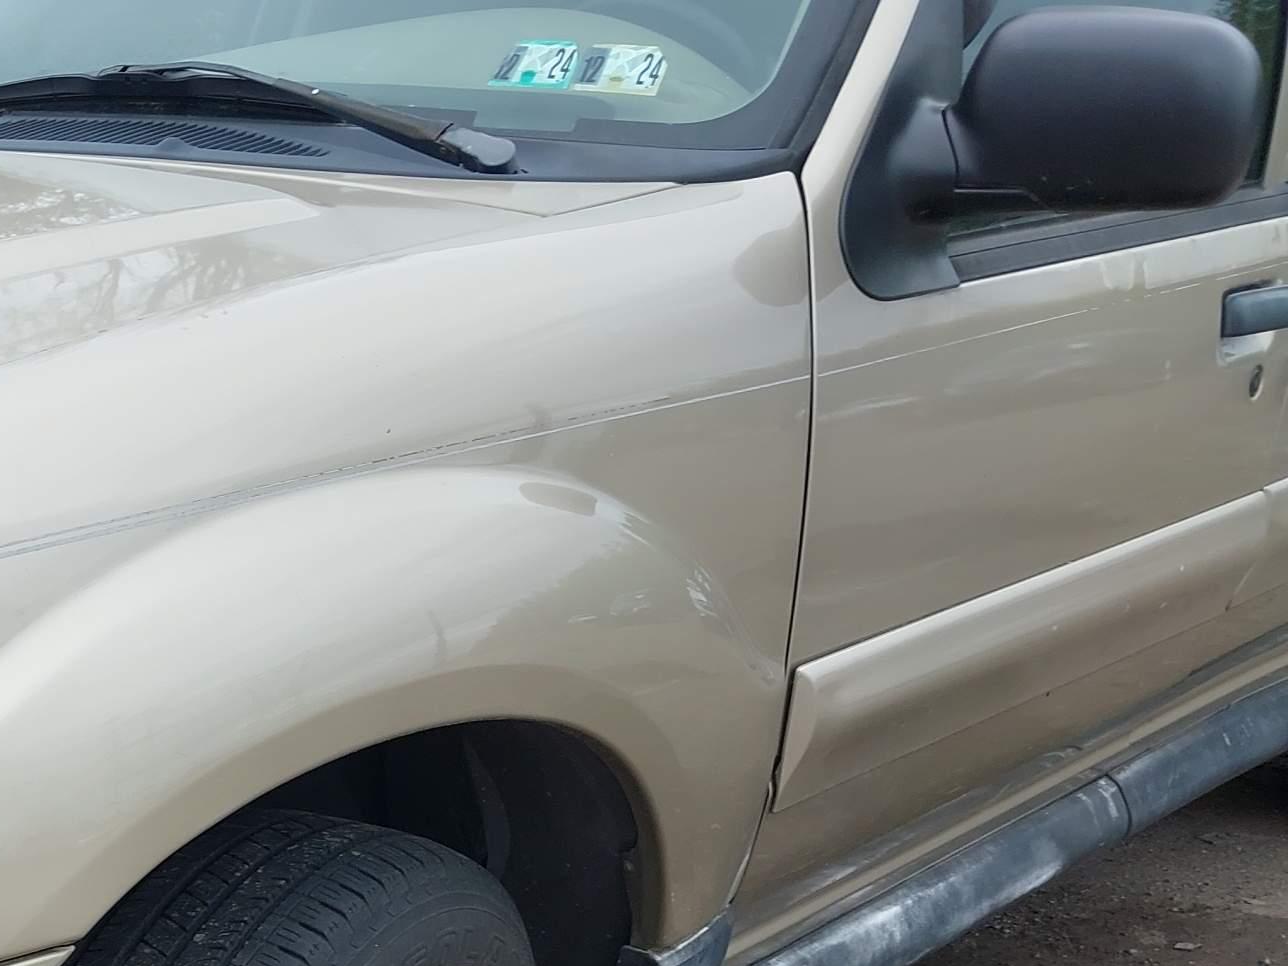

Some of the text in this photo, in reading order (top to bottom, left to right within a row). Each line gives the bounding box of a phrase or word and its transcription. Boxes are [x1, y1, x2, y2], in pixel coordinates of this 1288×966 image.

[494, 47, 577, 81] 12 24
[579, 53, 665, 86] 12 24
